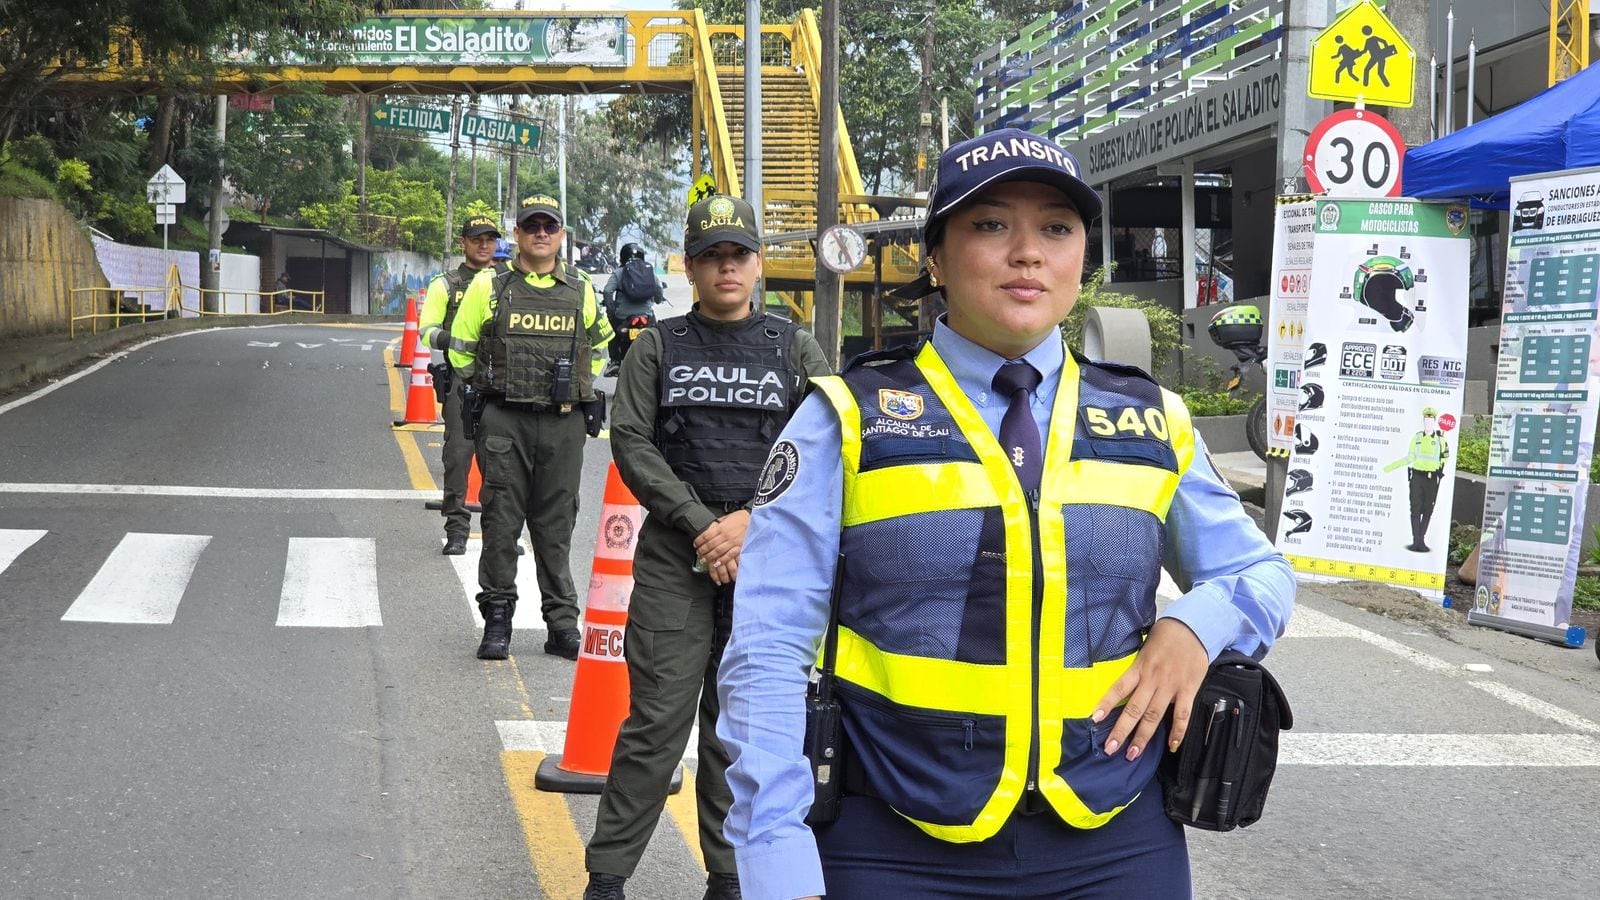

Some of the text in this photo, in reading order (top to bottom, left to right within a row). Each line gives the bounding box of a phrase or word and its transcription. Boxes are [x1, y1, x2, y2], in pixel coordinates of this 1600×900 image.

[395, 25, 417, 51] El
[425, 24, 531, 52] Saladito
[389, 107, 443, 130] FELIDIA
[1089, 73, 1282, 175] SUBESTACIÓN DE POLICÍA EL SALADITO
[466, 116, 517, 143] DAGUA
[955, 138, 1077, 178] TRANSITO
[1326, 135, 1390, 188] 30
[1548, 184, 1596, 201] SANCIONES
[521, 196, 559, 209] POLICIA
[1368, 203, 1414, 216] CASCO PARA
[1547, 202, 1580, 212] CONDUCTORES
[1585, 200, 1600, 208] ESTAD
[700, 217, 745, 231] GAULA
[1360, 219, 1419, 233] MOTOCICLISTAS
[1546, 212, 1600, 226] DE EMBRIAGUEZ
[509, 313, 576, 332] POLICIA
[1344, 344, 1375, 353] APPROVED
[1343, 352, 1374, 370] ECE
[1382, 358, 1406, 371] DOT
[1422, 358, 1462, 371] RES NTC
[668, 365, 784, 389] GAULA
[1342, 381, 1388, 391] CERTIFICACIONES
[1388, 384, 1412, 393] VÁLIDAS
[1420, 387, 1451, 395] COLOMBIA
[667, 385, 784, 408] POLICÍA
[876, 418, 932, 432] ALCALDÍA DE
[1085, 406, 1169, 441] 540
[1437, 418, 1456, 429] PARE
[861, 425, 949, 438] SANTIAGO DE CALI
[583, 626, 625, 657] MEC
